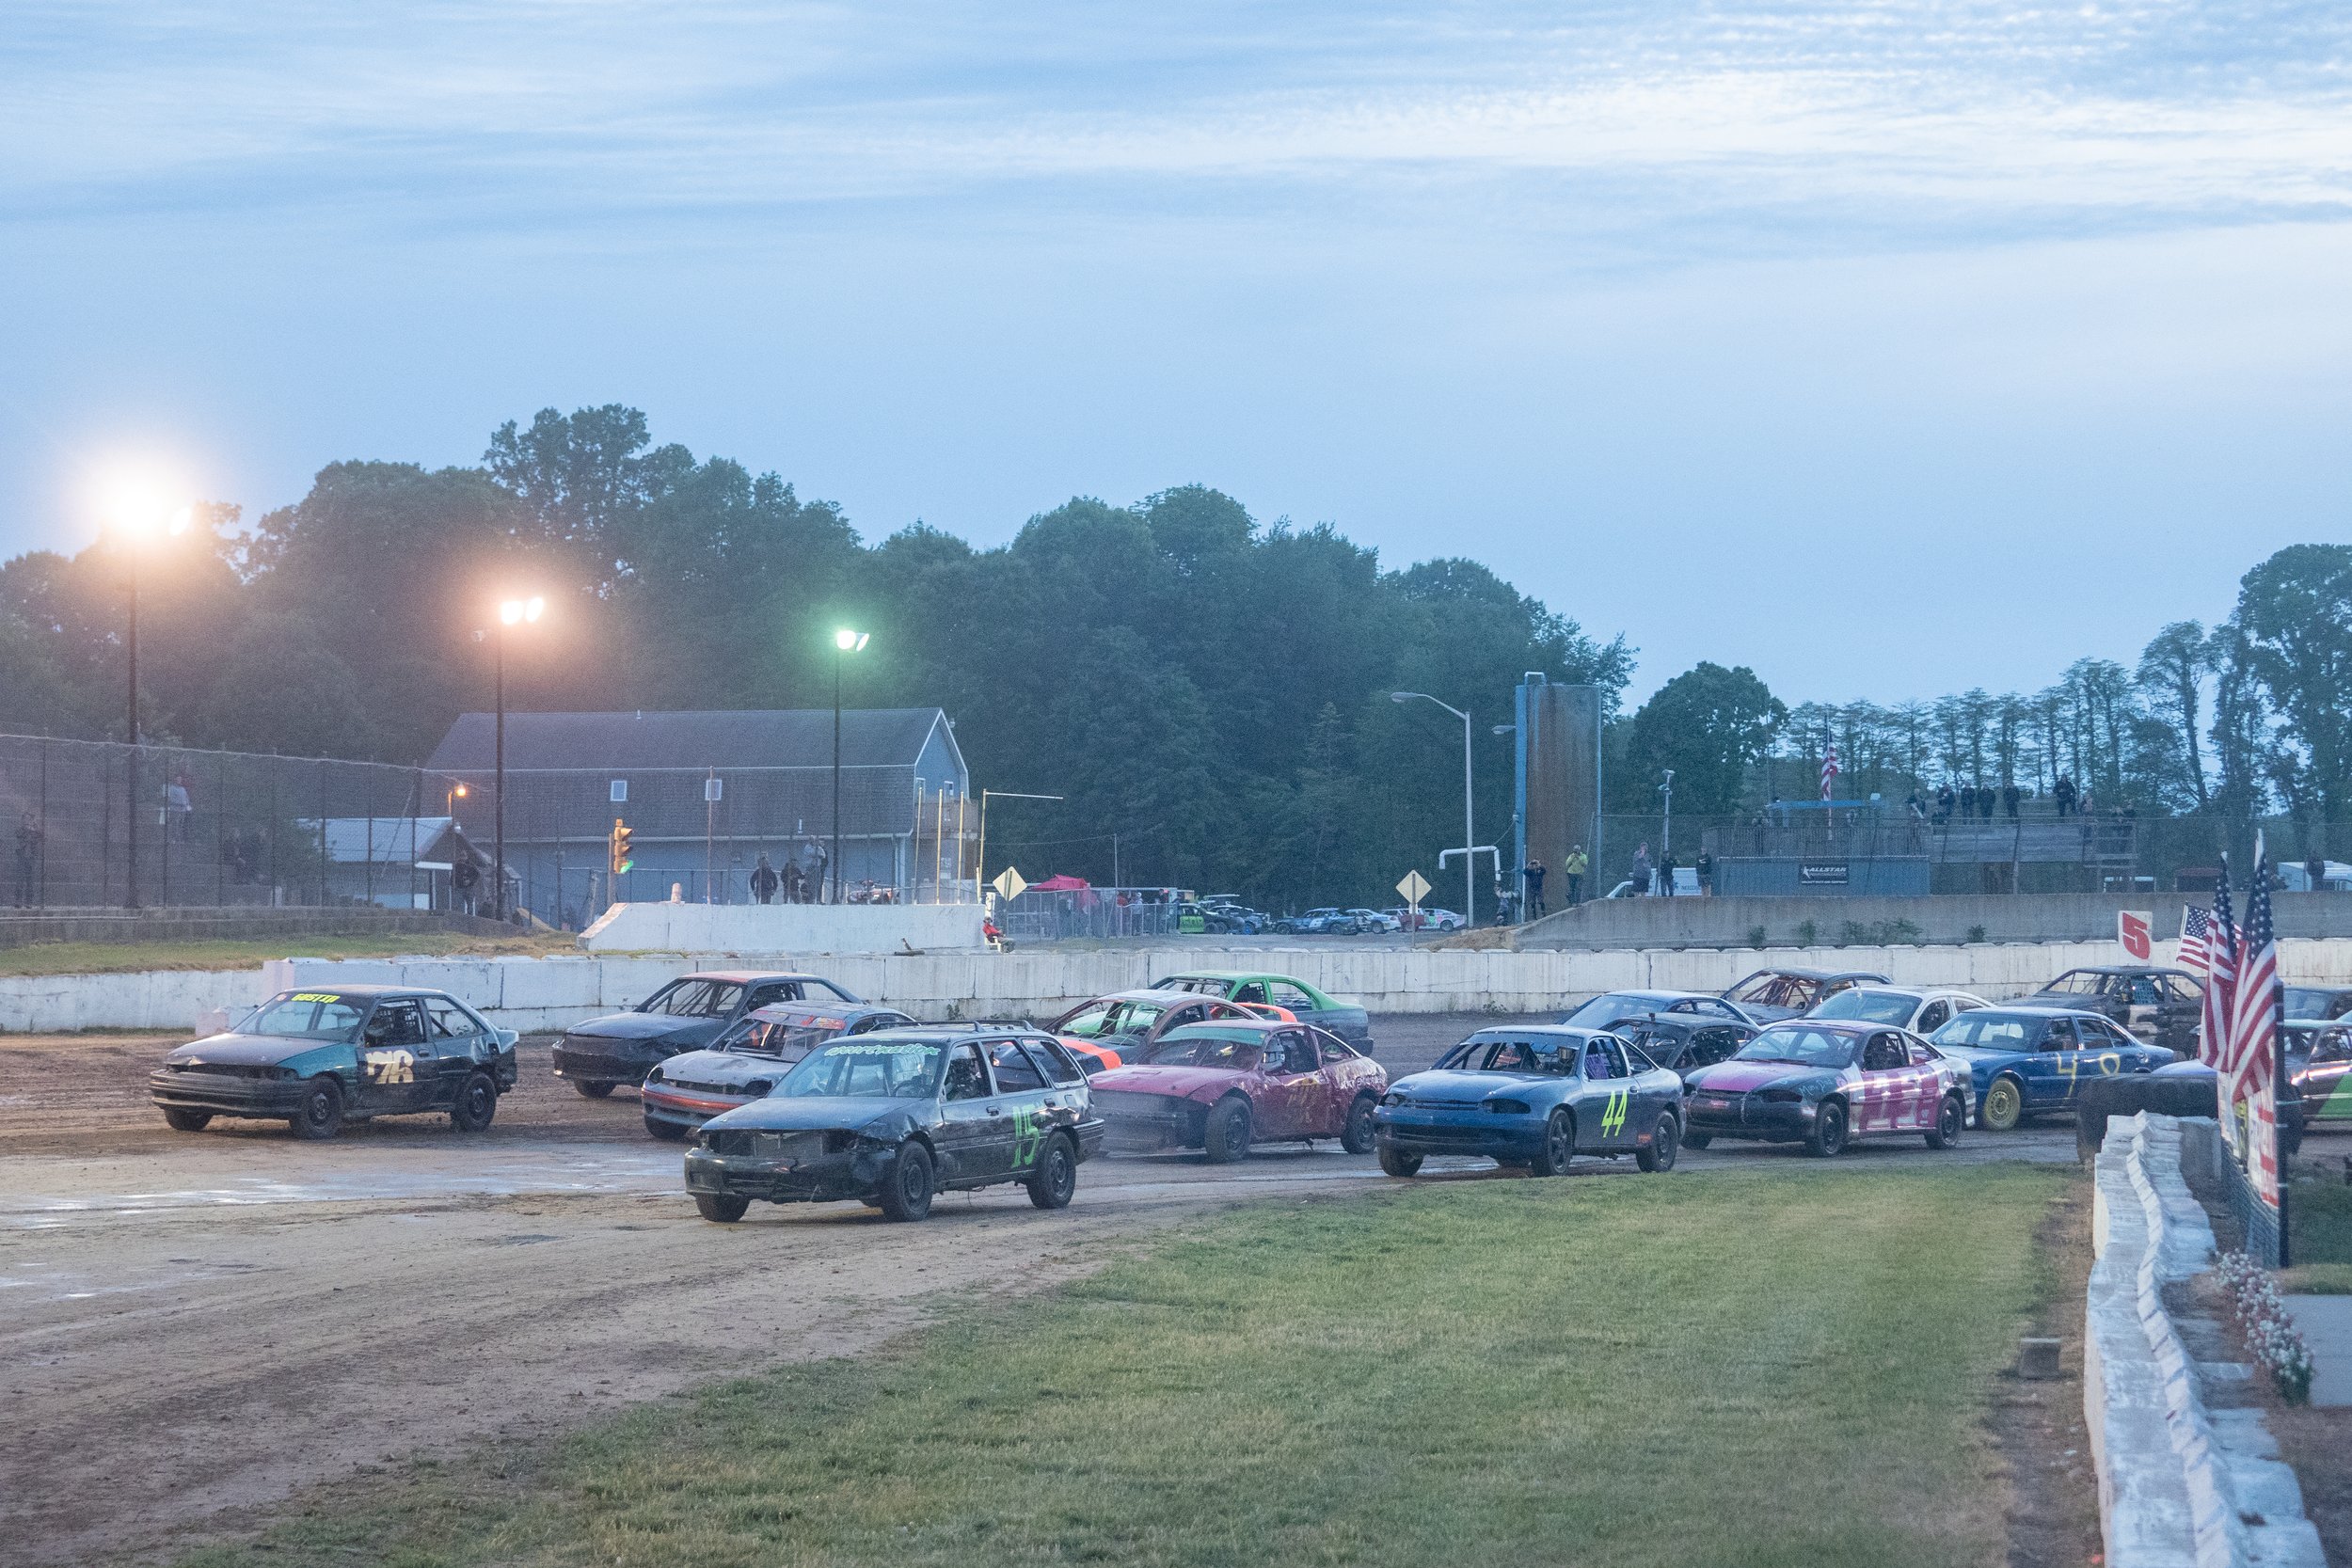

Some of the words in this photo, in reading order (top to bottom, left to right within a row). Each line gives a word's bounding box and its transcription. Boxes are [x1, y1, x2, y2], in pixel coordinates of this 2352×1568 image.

[2122, 912, 2150, 959] 5
[365, 1050, 414, 1084] 76
[1011, 1104, 1040, 1168] 15
[1601, 1089, 1628, 1138] 44
